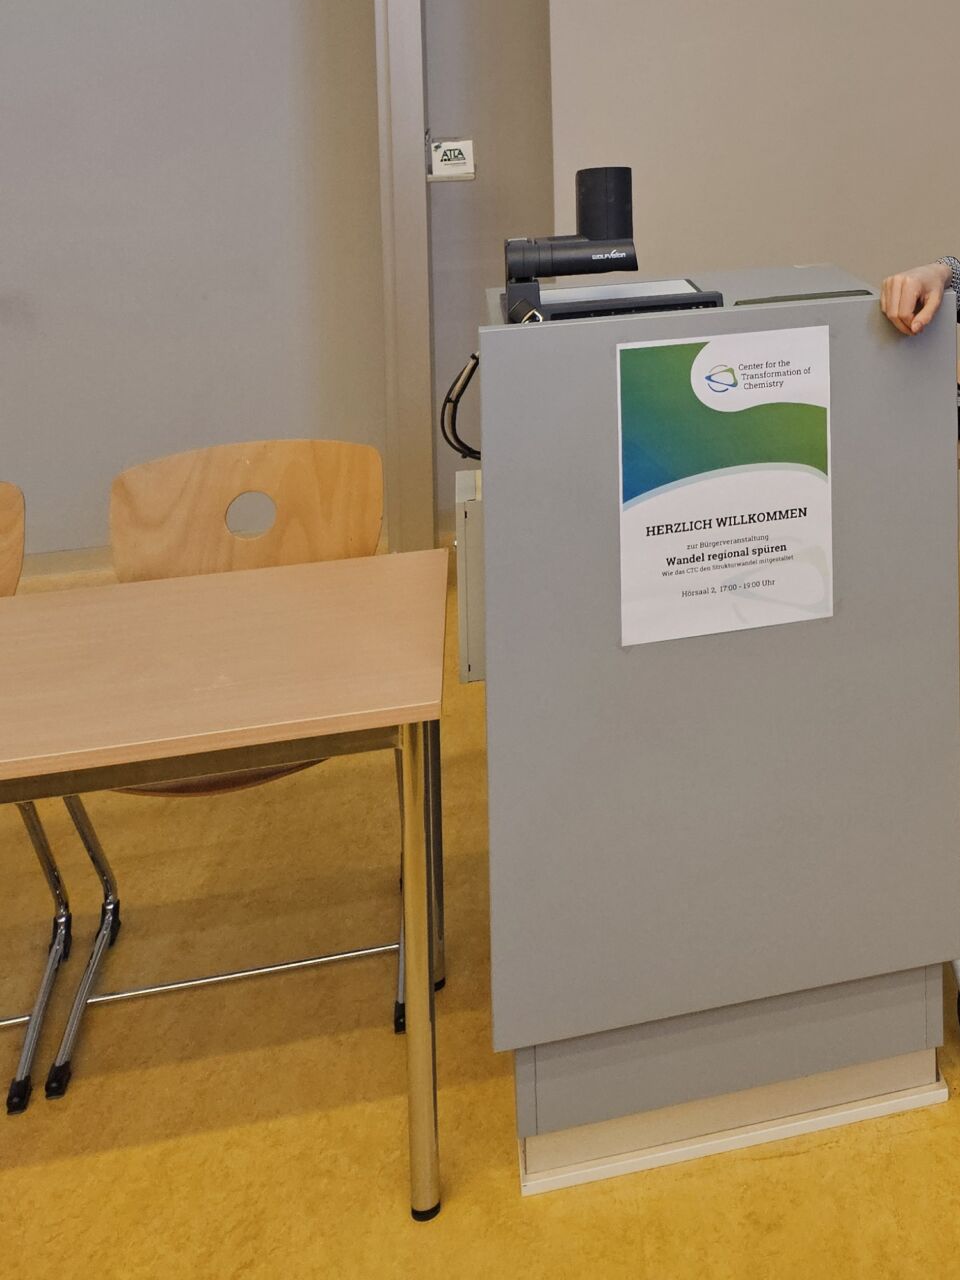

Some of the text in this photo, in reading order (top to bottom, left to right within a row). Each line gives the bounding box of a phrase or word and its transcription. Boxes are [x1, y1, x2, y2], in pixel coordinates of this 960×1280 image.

[738, 359, 790, 371] Center for the
[741, 366, 811, 381] Transformation of
[743, 380, 784, 390] Chemistry
[646, 507, 807, 536] HERZLICH WILLKOMMEN
[699, 534, 769, 549] Bürgerveranstaltung
[665, 544, 787, 567] Wandel regional spüren
[761, 579, 775, 587] Uhr
